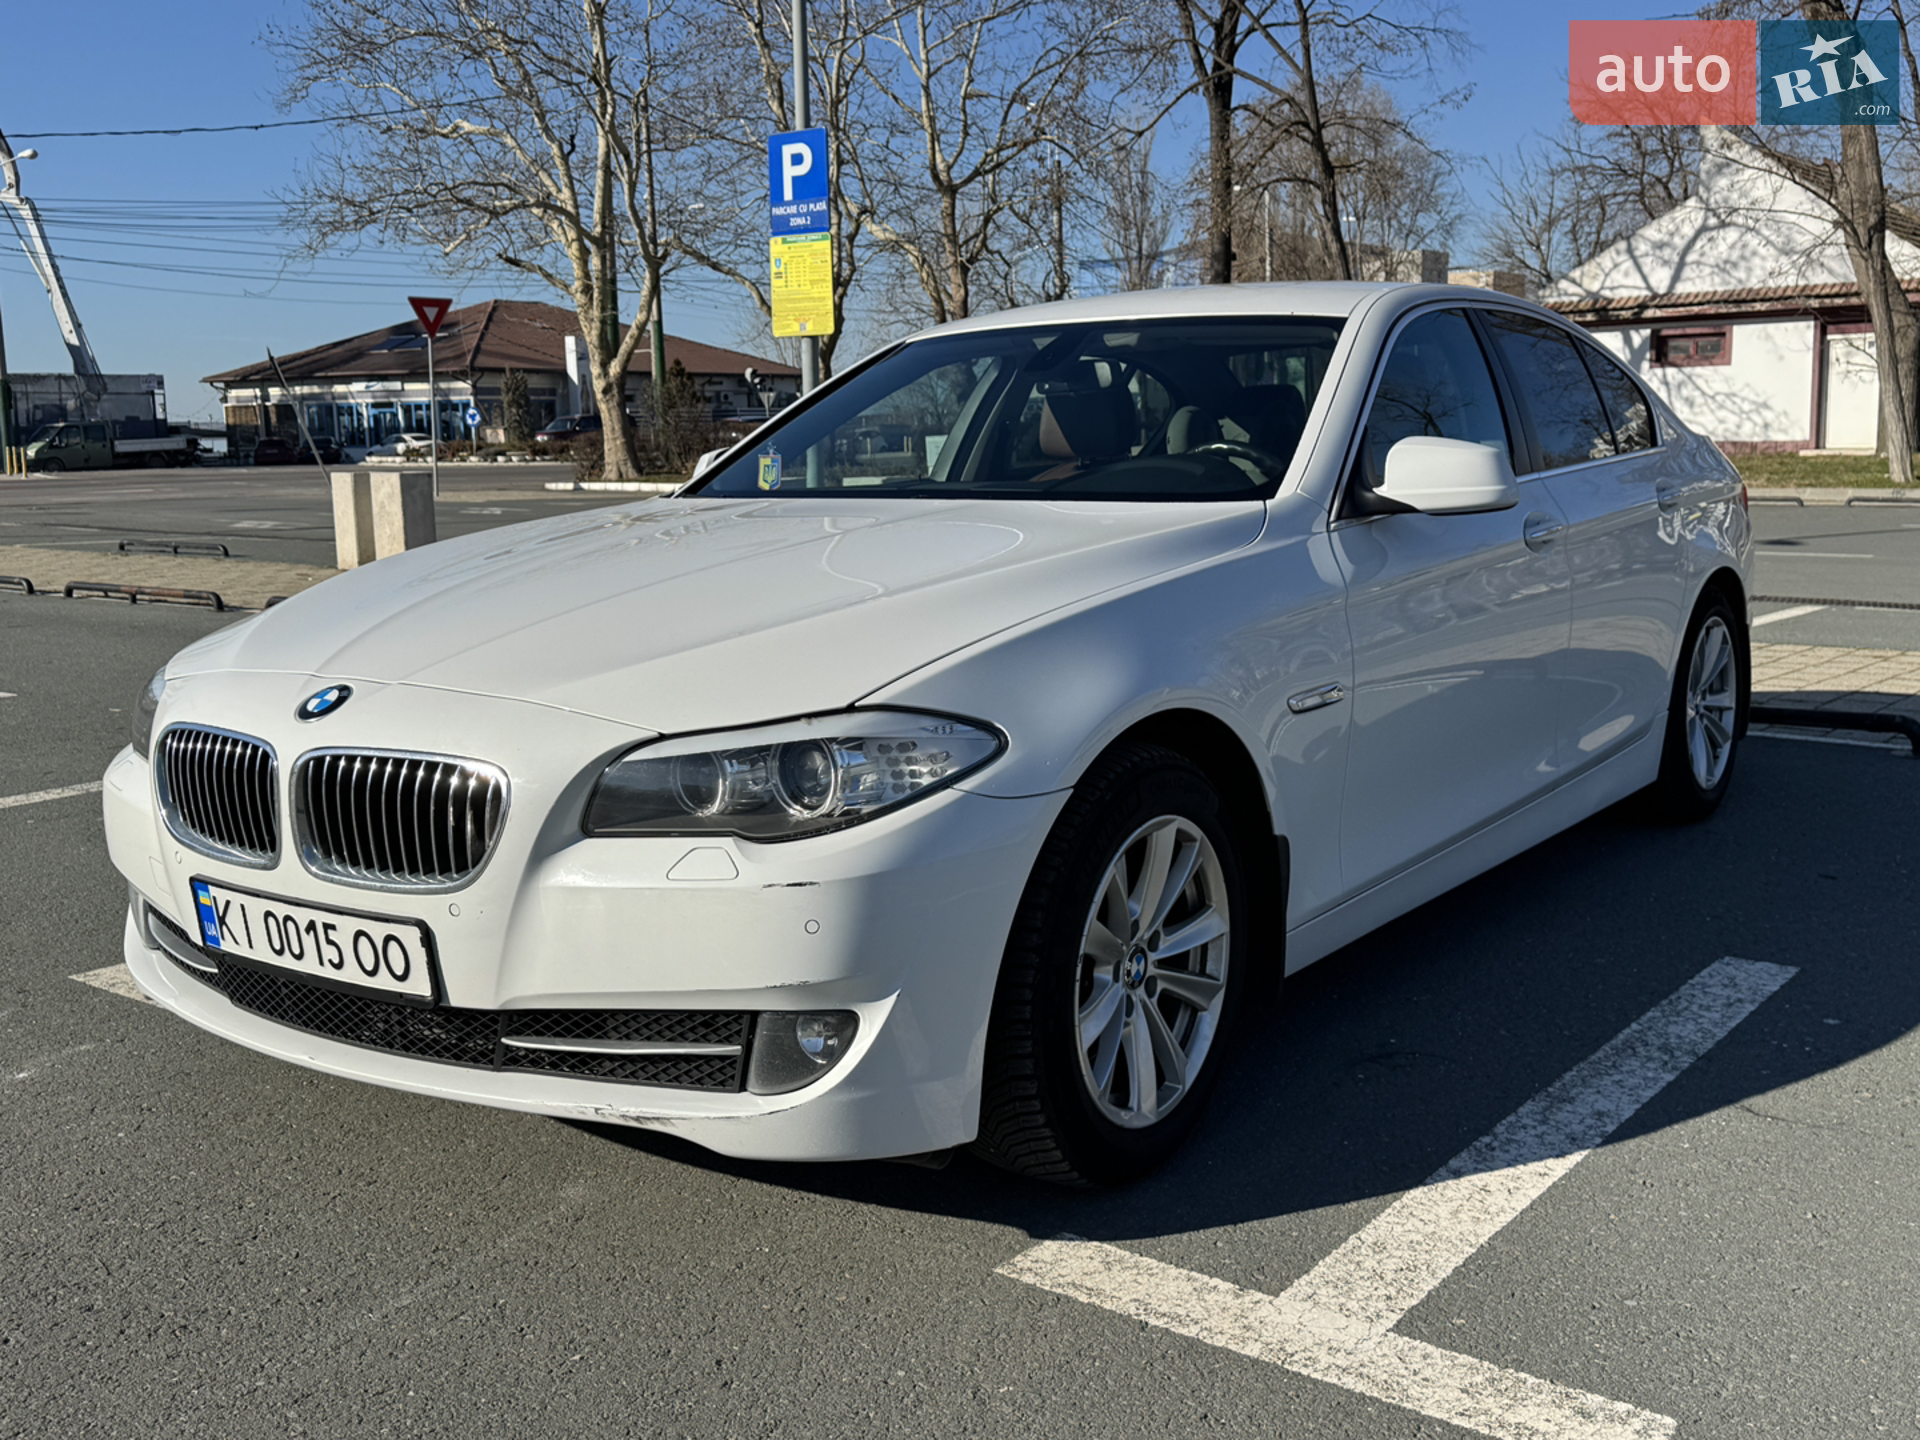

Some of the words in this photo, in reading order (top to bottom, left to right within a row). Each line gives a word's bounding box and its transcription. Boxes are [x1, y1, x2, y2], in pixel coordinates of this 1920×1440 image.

[782, 142, 813, 202] P
[772, 204, 798, 216] PARCARE
[798, 203, 808, 213] CU
[789, 216, 806, 227] ZONA
[204, 921, 218, 939] UA
[213, 895, 253, 949] KI
[263, 910, 344, 970] 0015
[353, 929, 410, 982] OO
